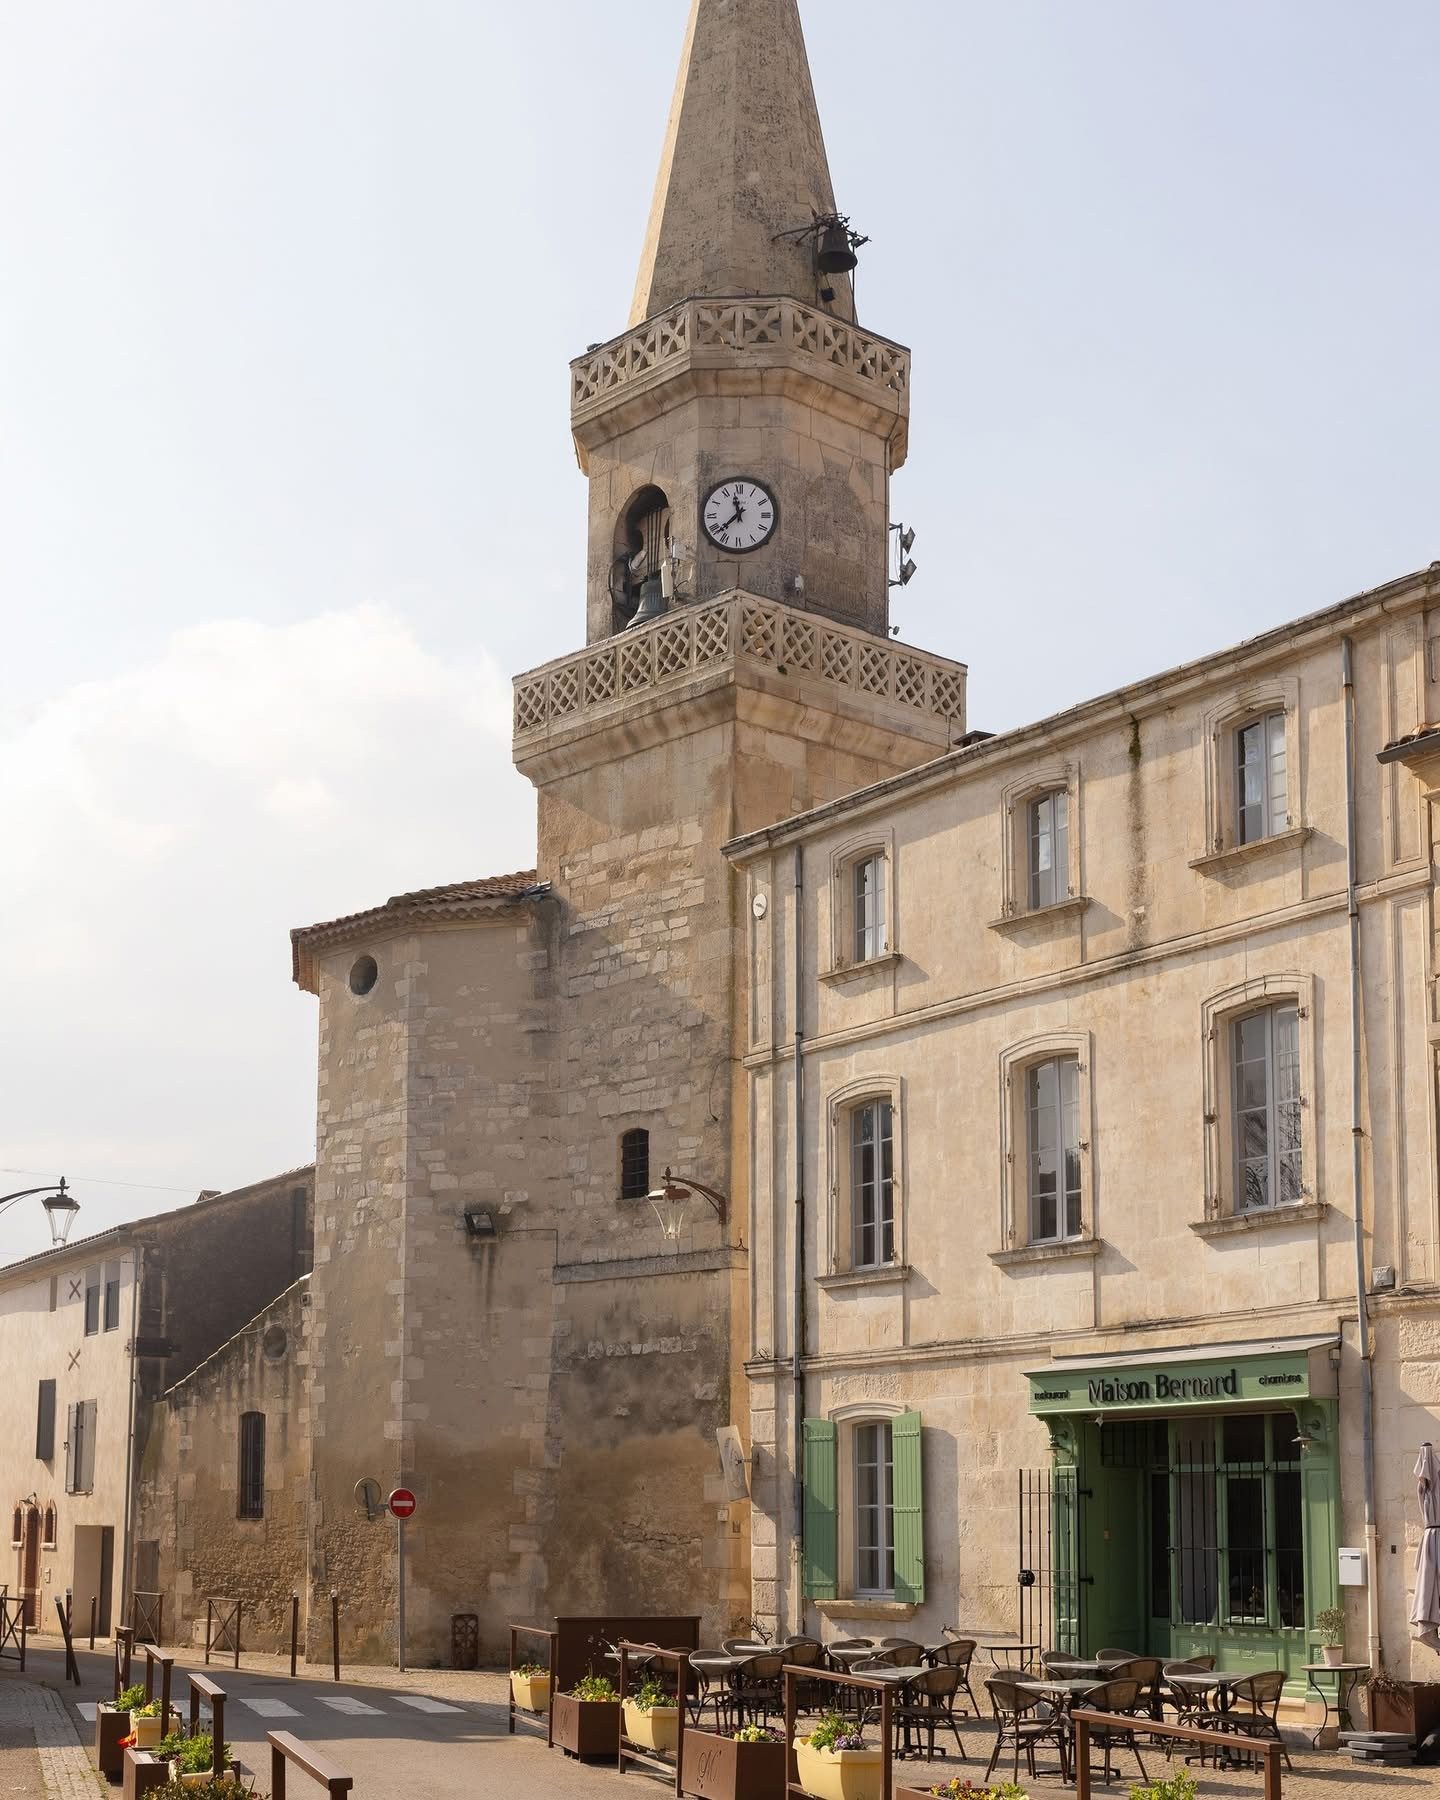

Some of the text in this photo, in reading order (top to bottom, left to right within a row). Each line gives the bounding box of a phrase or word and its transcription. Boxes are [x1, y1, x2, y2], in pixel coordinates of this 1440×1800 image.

[735, 484, 744, 494] XII
[1088, 1368, 1237, 1403] Maison Bernard
